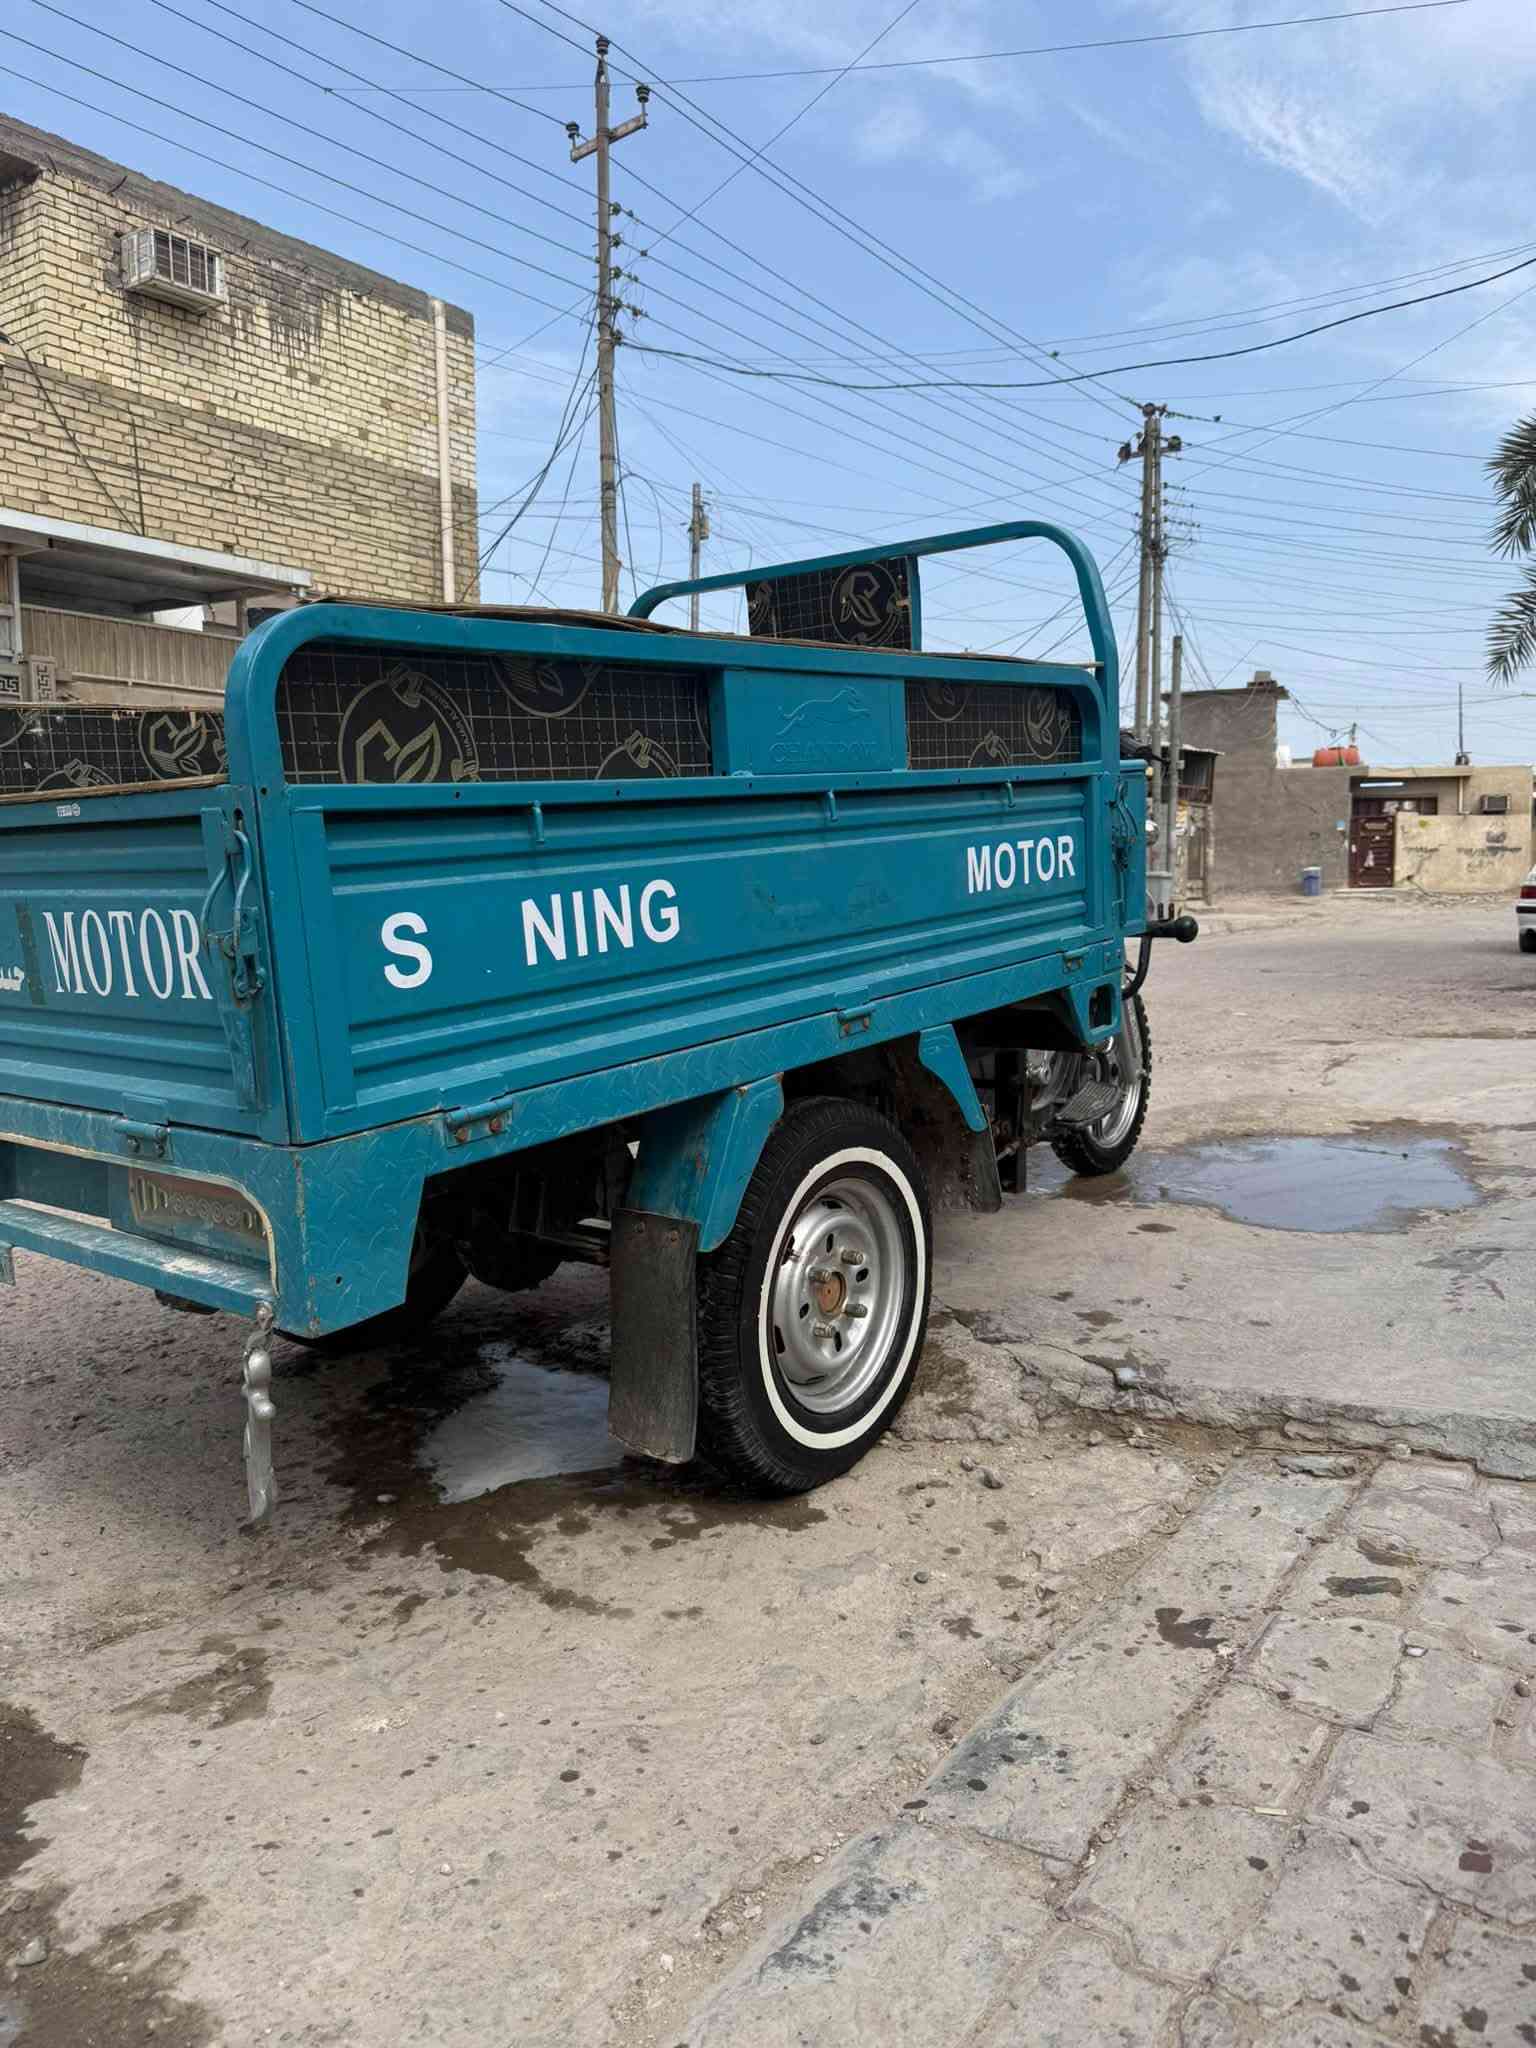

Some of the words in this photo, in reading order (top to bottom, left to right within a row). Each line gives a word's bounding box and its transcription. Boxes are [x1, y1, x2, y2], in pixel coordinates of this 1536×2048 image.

[43, 908, 213, 999] MOTOR
[381, 911, 433, 989] S
[521, 879, 680, 966] NING
[967, 835, 1075, 894] MOTOR
